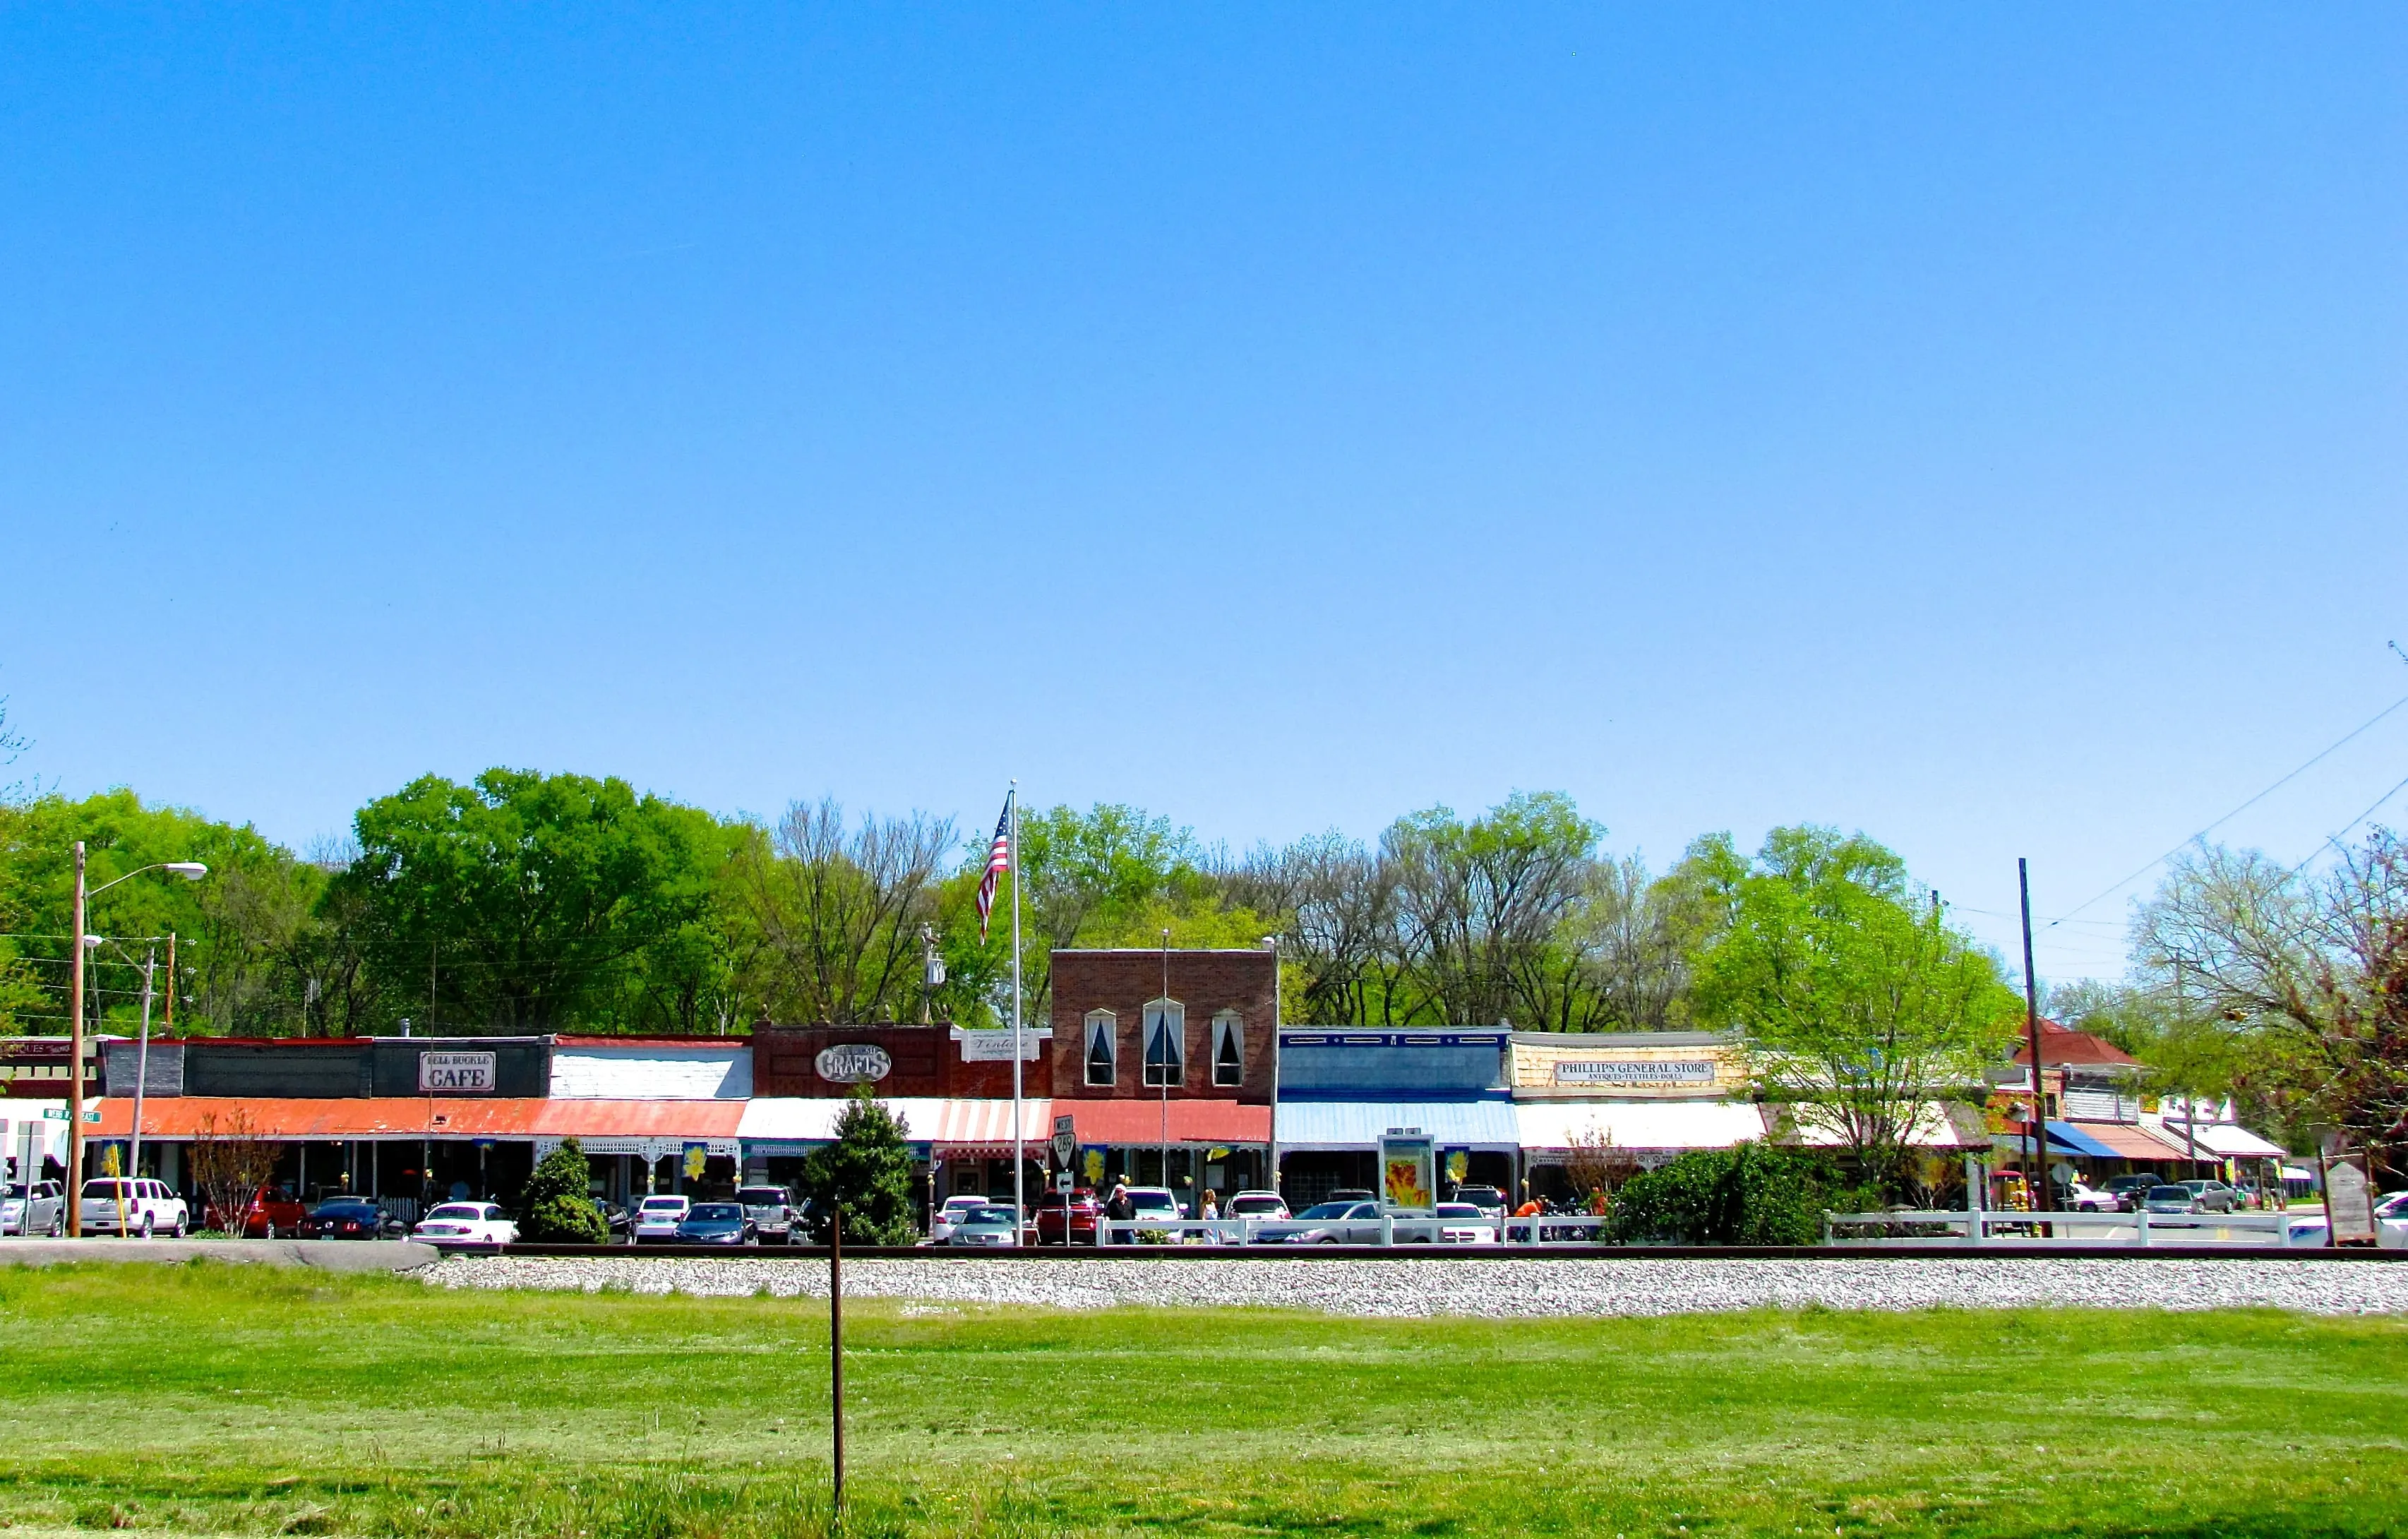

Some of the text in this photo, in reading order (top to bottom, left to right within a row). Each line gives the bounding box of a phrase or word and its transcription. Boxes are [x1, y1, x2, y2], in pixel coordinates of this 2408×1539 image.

[973, 1038, 1029, 1049] Vintae
[453, 1055, 489, 1065] BUCKLE
[822, 1053, 882, 1077] CRAFTS
[1562, 1063, 1708, 1073] PHILLIPS GENERAL STORE
[429, 1069, 485, 1087] CAFE
[1057, 1119, 1071, 1130] WEST
[1057, 1135, 1072, 1152] 269
